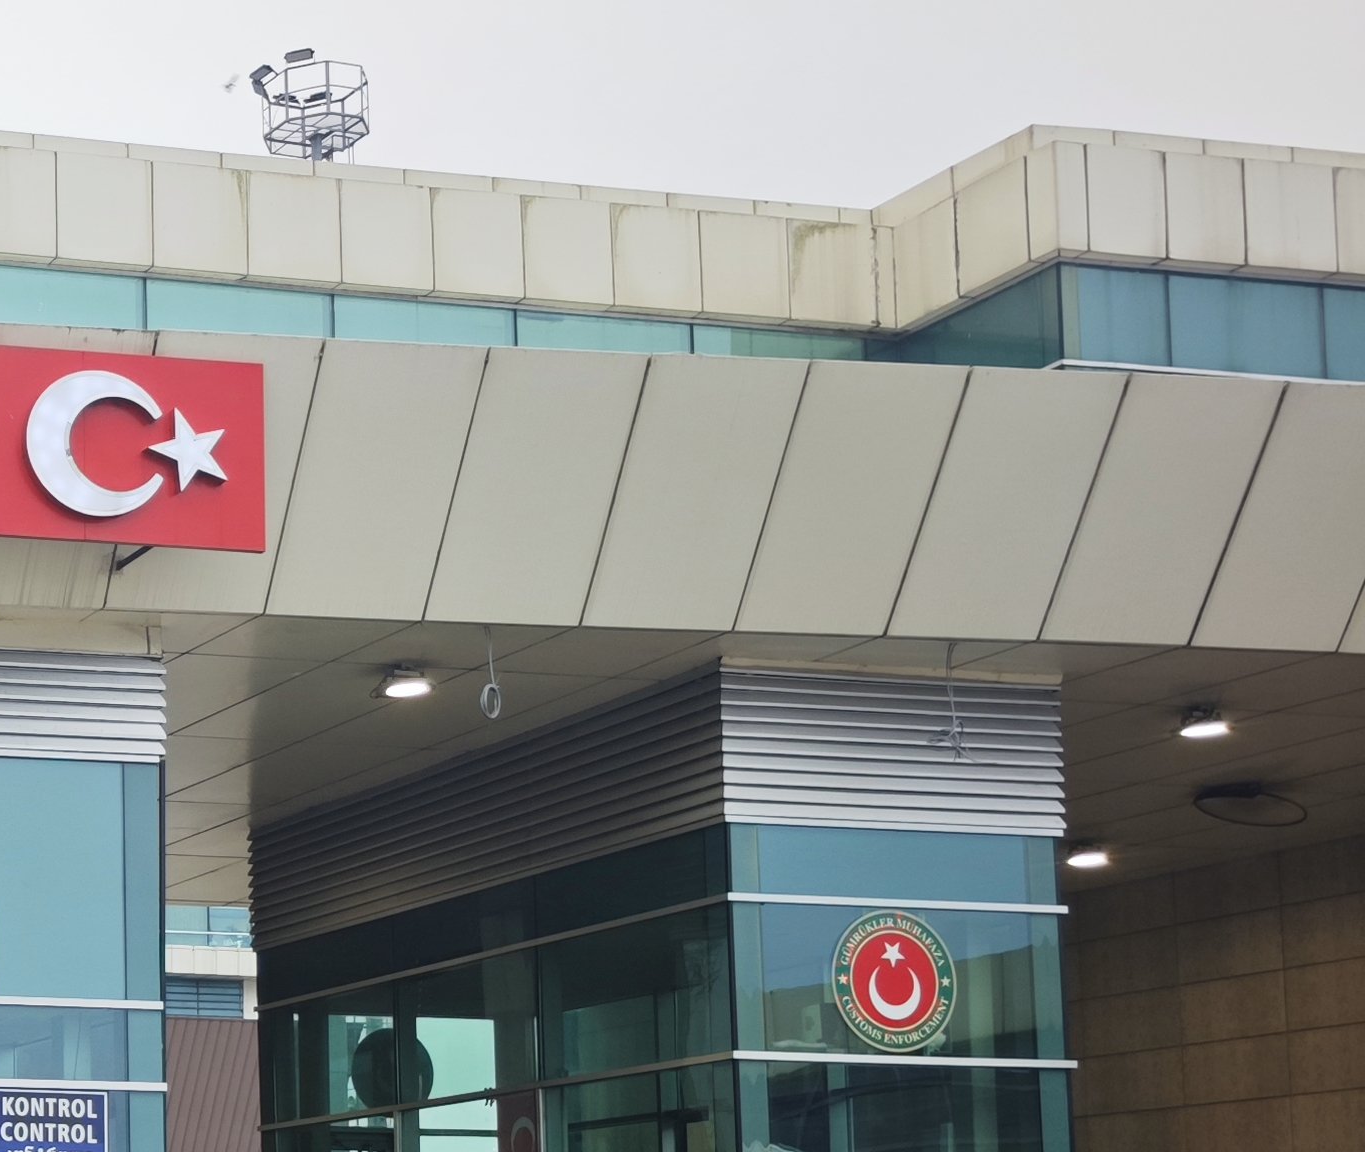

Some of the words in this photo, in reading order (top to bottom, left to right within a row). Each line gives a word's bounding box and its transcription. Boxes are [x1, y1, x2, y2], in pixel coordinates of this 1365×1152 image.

[840, 917, 895, 966] GÜMRÜKLER
[896, 918, 945, 967] MUHAFAZA
[842, 995, 882, 1041] CUSTOMS
[883, 996, 950, 1045] ENFORCEMENT
[1, 1096, 98, 1119] KONTROL
[0, 1121, 98, 1144] CONTROL
